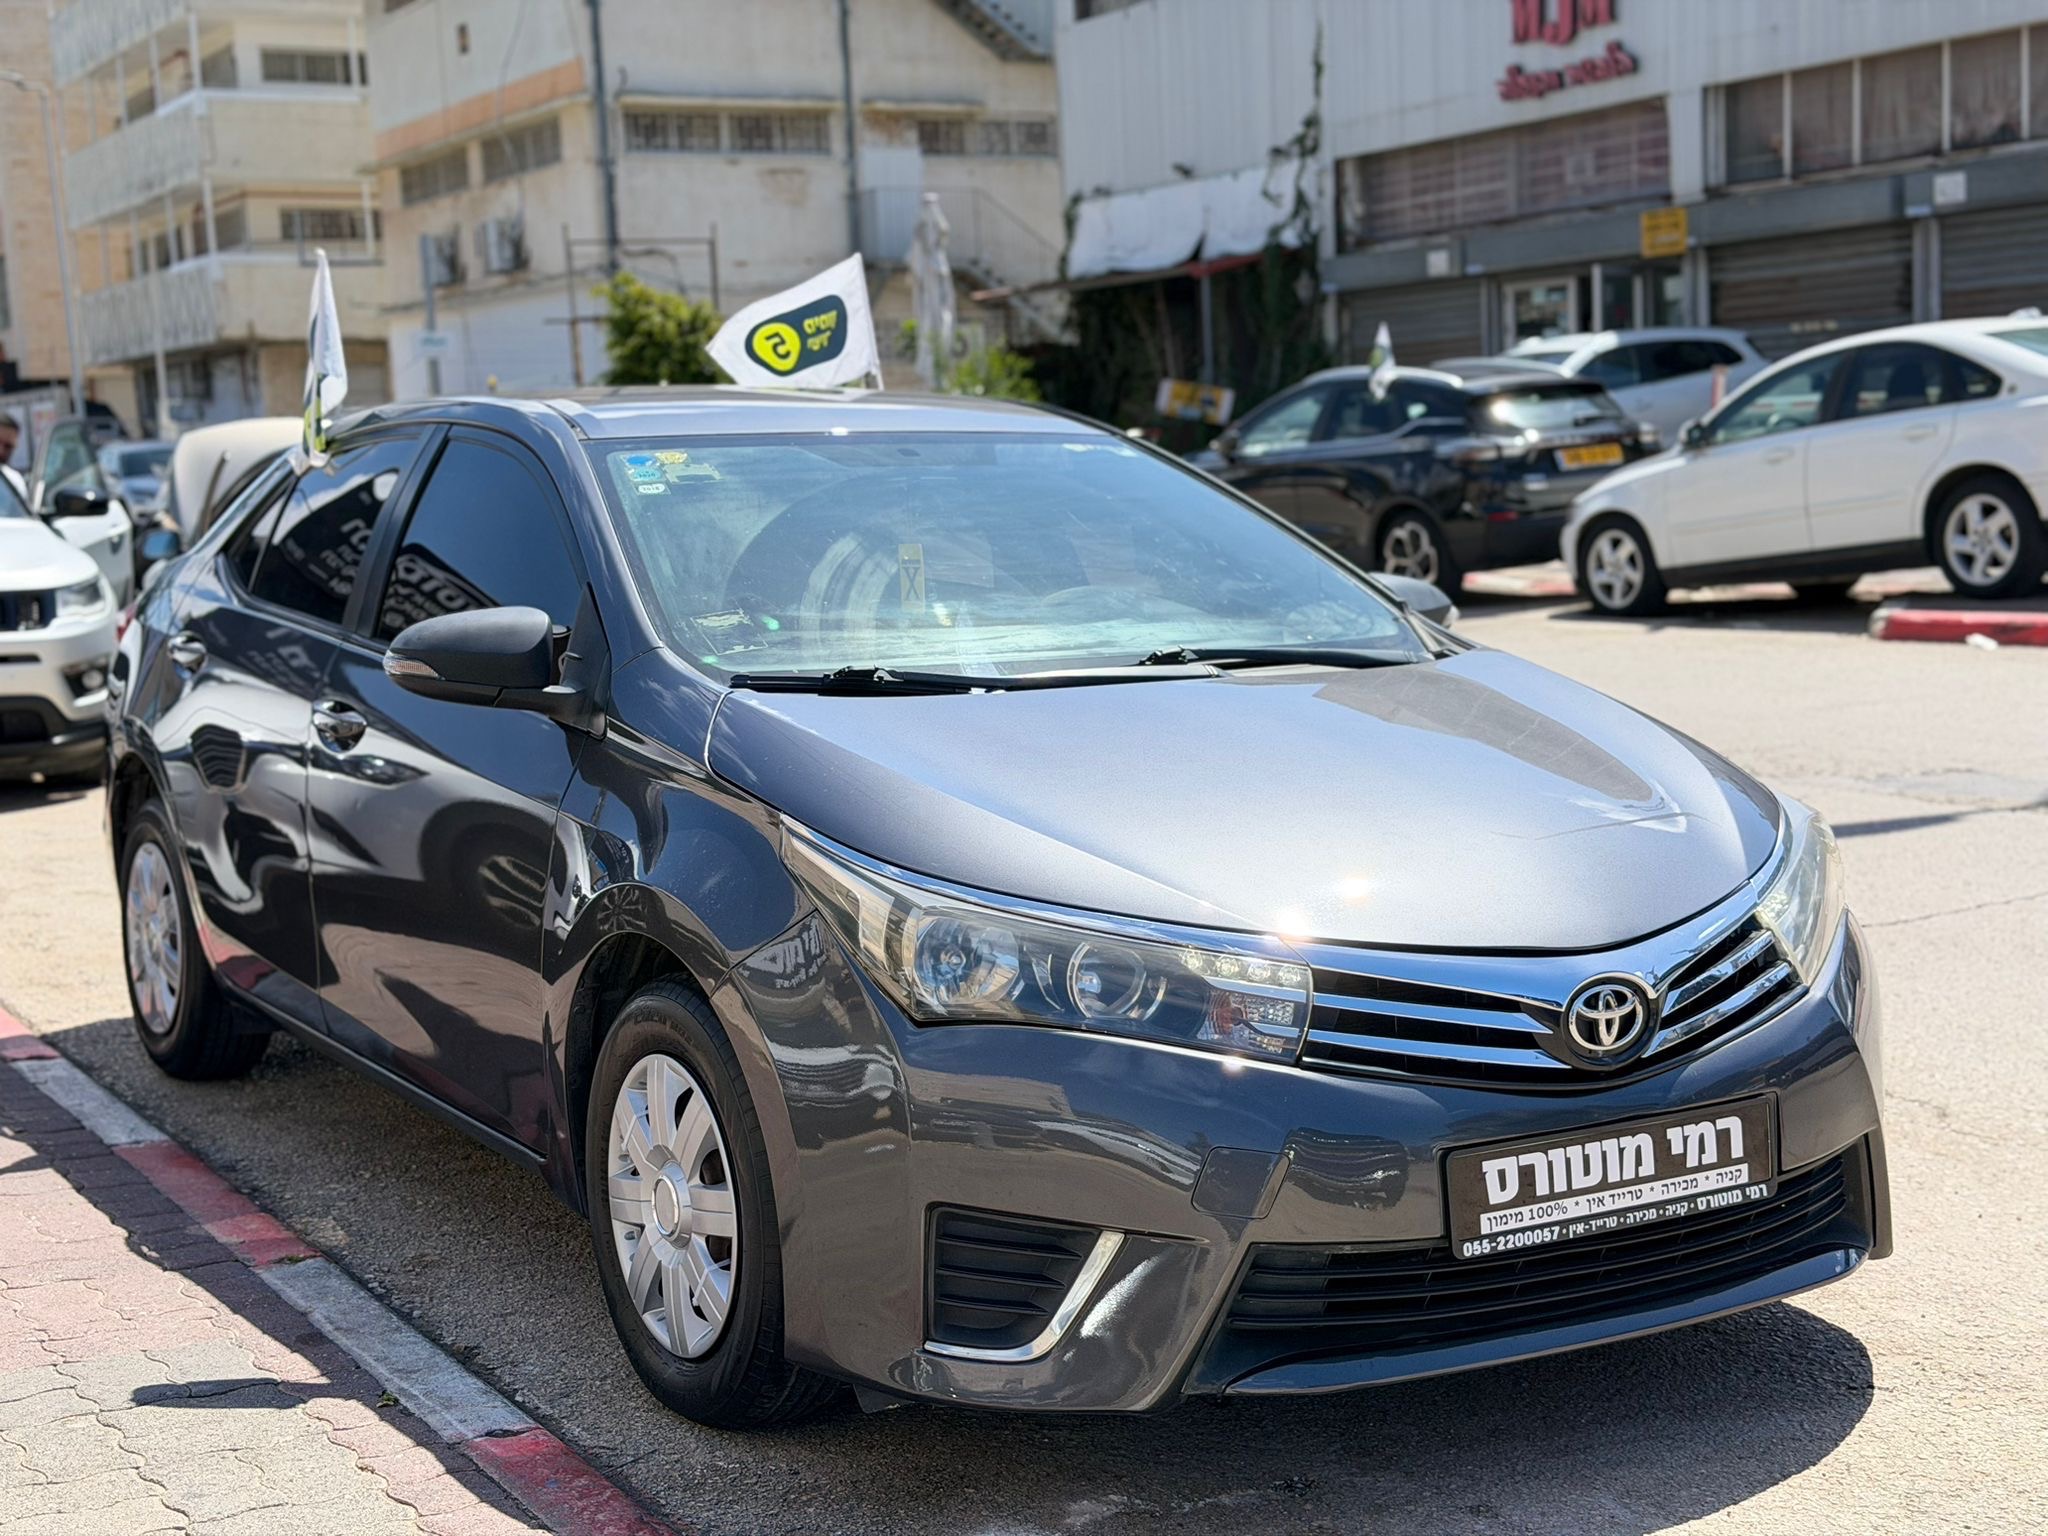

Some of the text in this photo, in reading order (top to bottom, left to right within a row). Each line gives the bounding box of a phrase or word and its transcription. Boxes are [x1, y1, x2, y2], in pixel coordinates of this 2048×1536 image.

[1481, 1115, 1744, 1205] רמי מוטורס
[1463, 1184, 1767, 1257] רמי מוטורס קניה מכירה טרייד-אין 055-2200057
[1487, 1168, 1742, 1231] קניה מכירה טרייד אין 100% מימון
